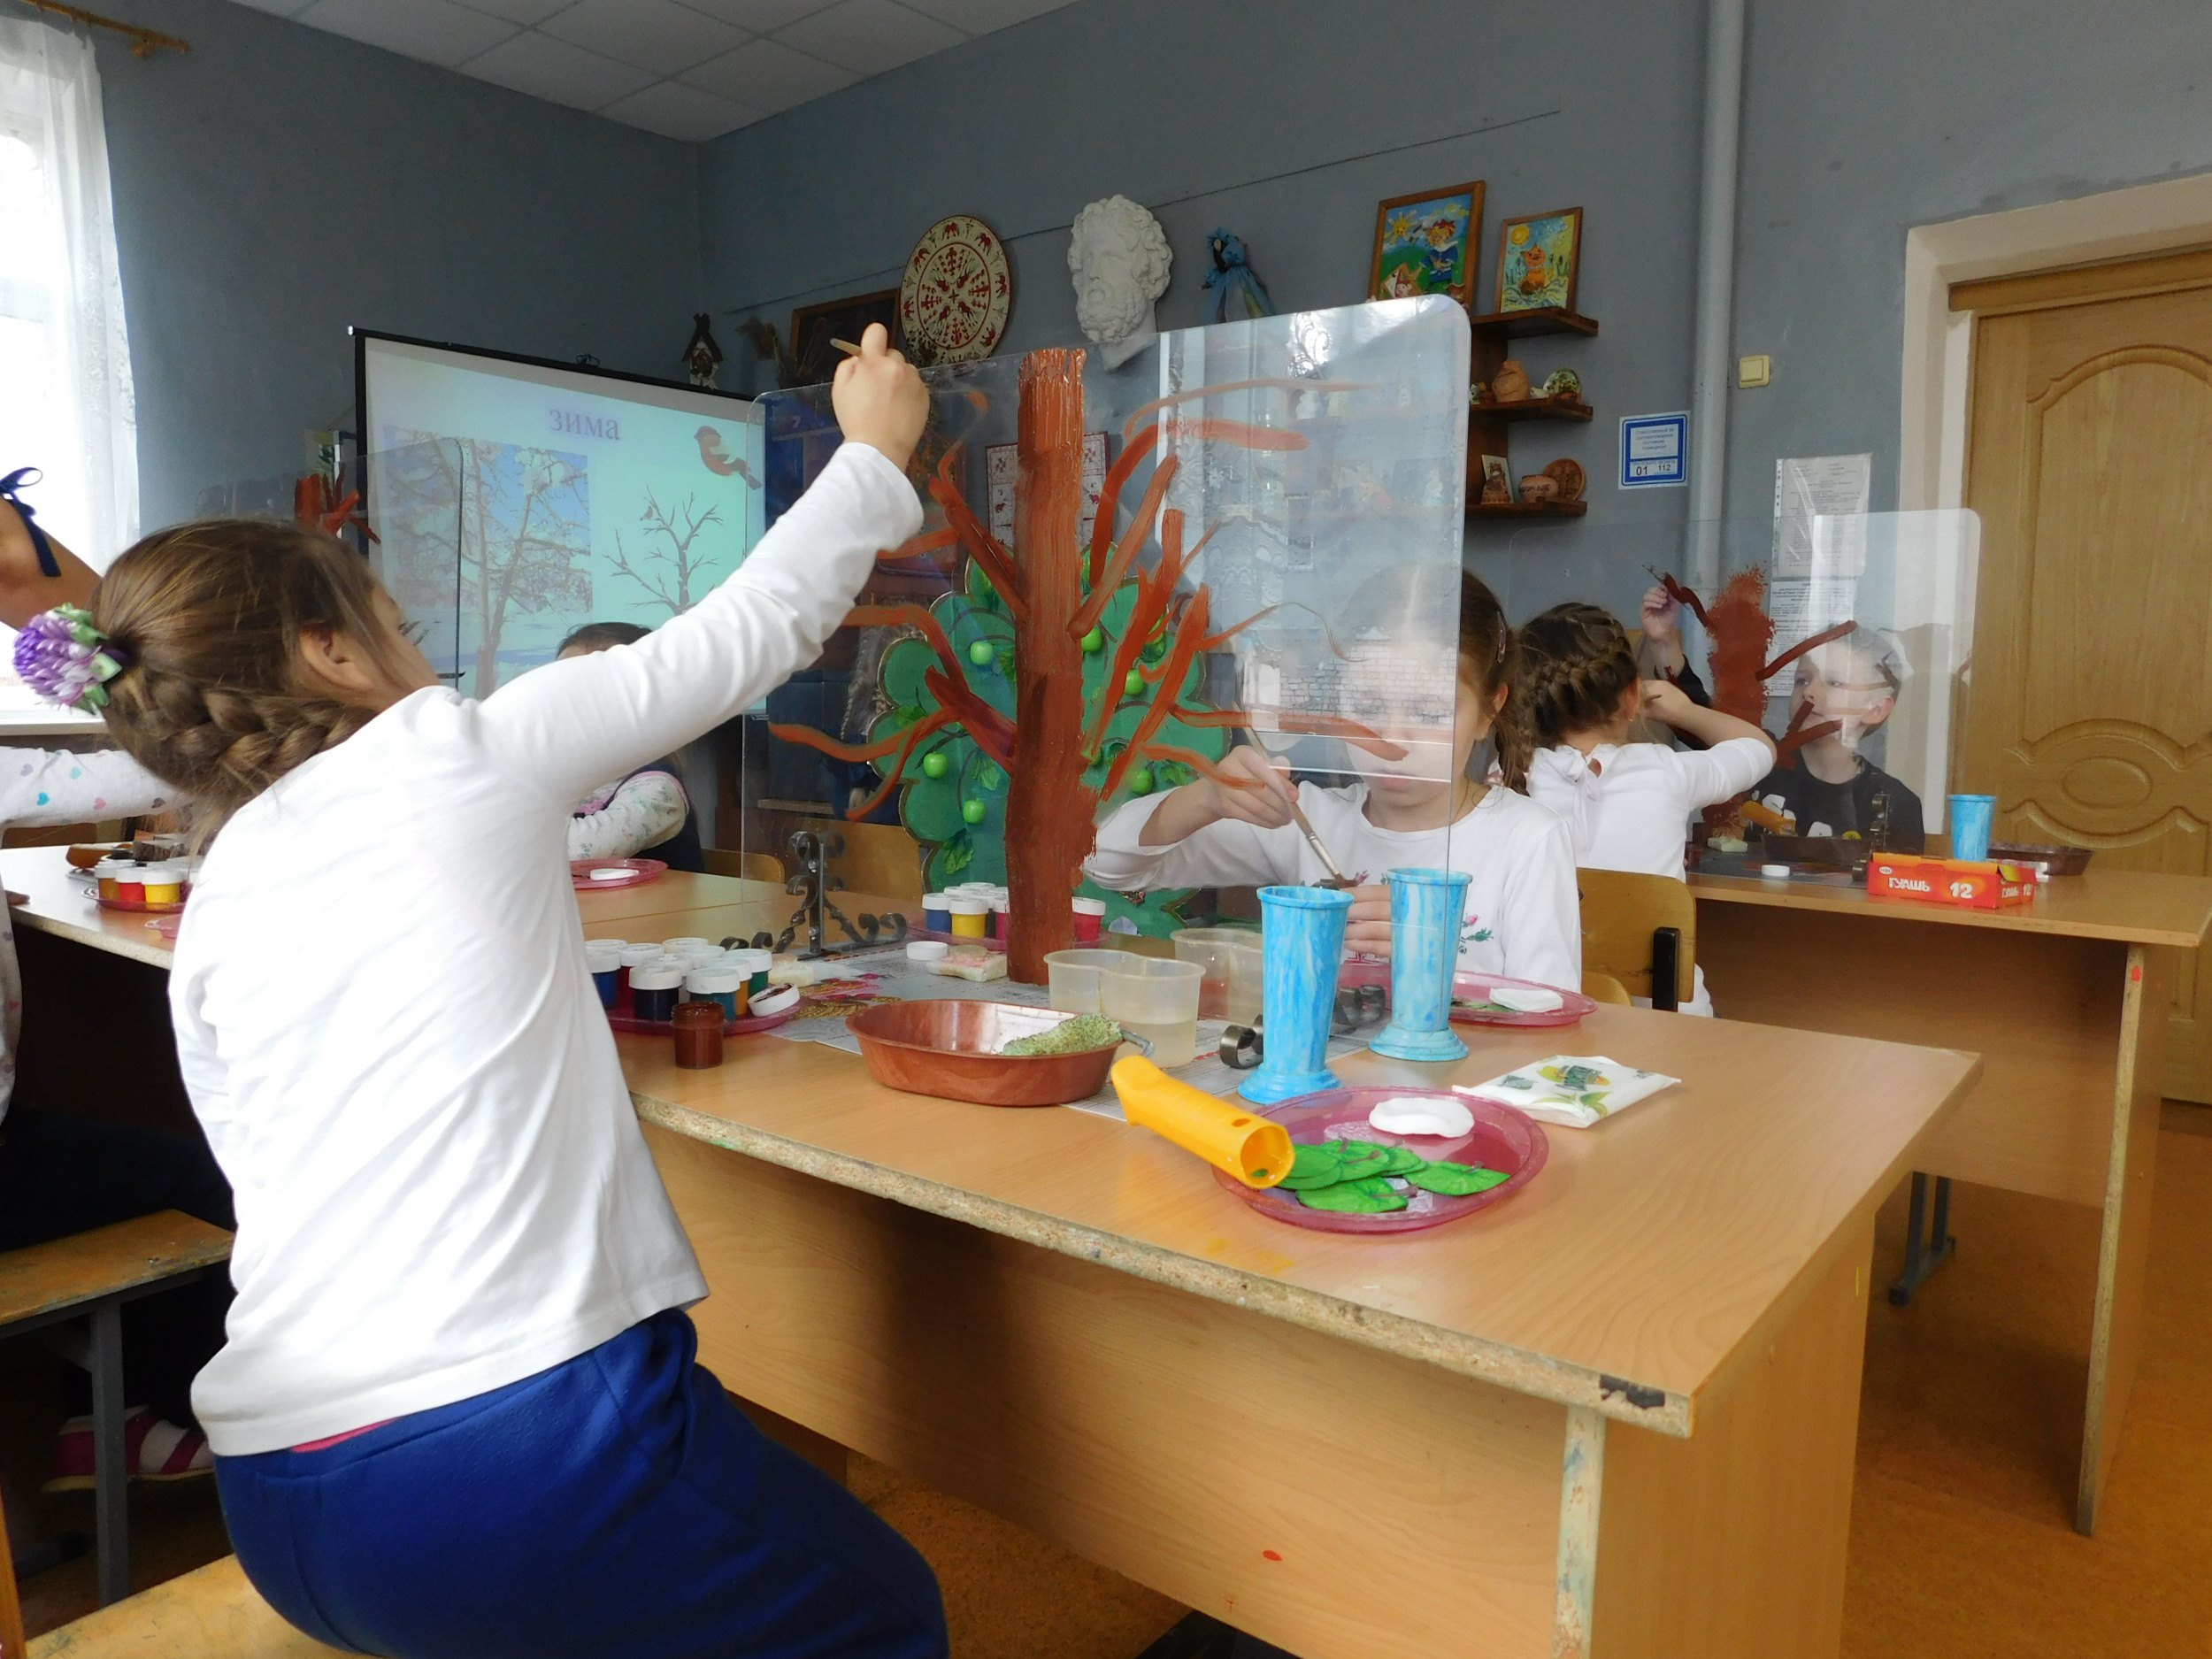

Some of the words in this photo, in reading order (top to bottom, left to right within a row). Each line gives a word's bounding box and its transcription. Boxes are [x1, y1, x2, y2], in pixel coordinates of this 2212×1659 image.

[549, 409, 620, 441] зима
[1636, 465, 1647, 476] 01
[1888, 877, 1931, 892] ГУАШЬ
[1949, 881, 1973, 899] 12
